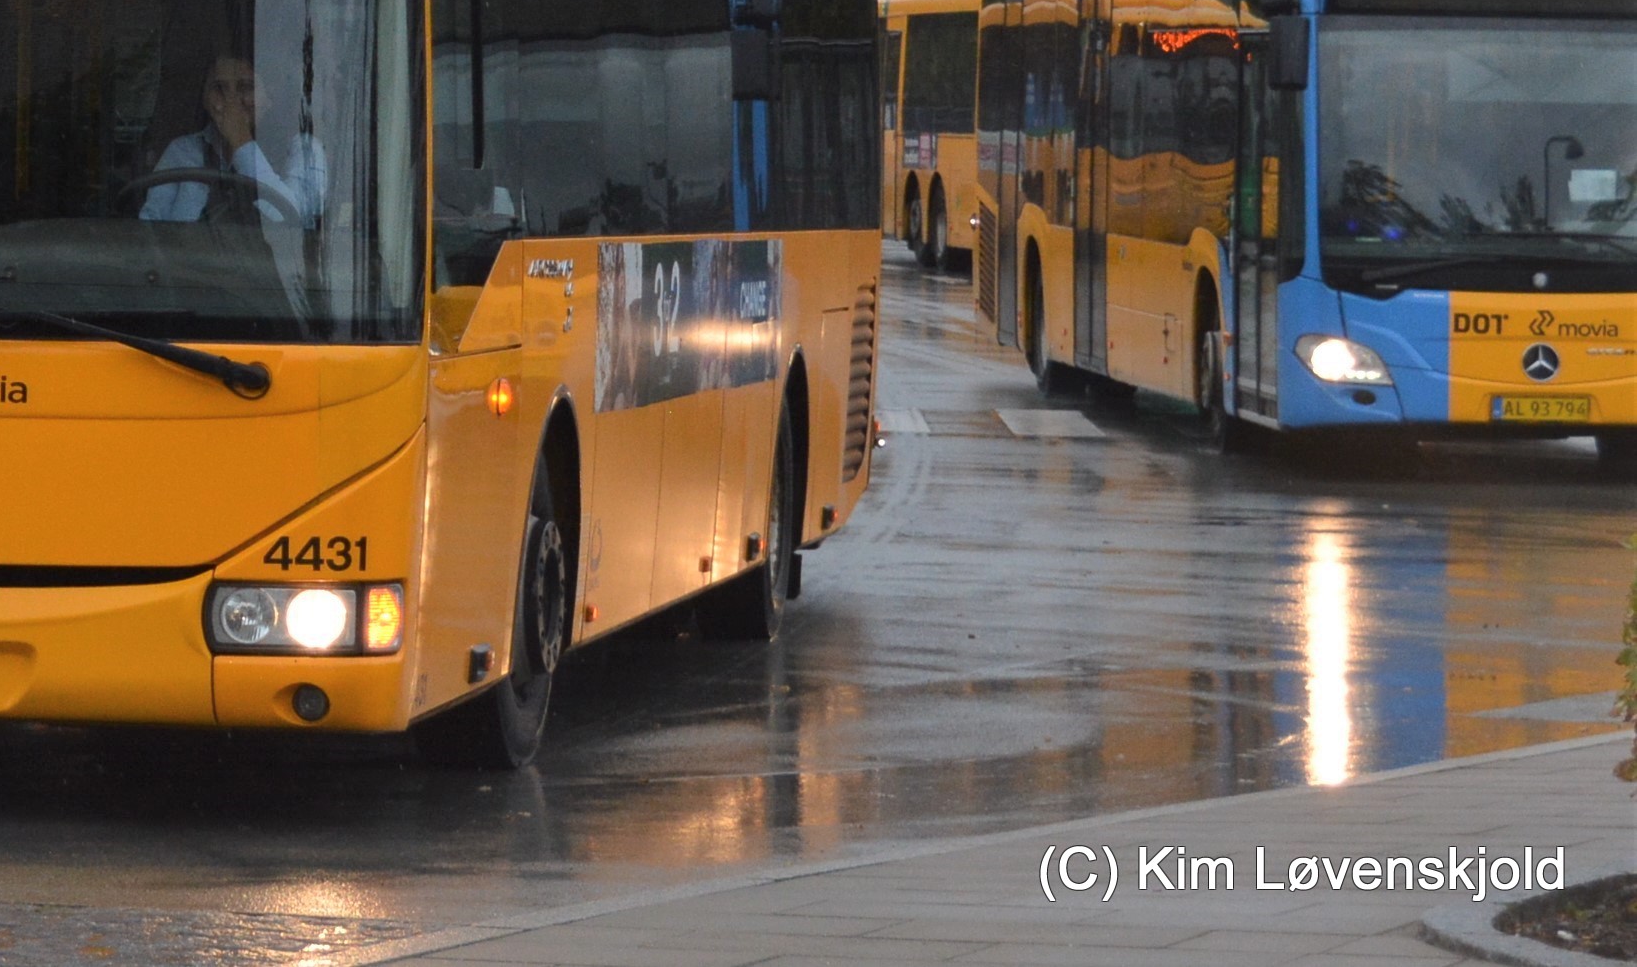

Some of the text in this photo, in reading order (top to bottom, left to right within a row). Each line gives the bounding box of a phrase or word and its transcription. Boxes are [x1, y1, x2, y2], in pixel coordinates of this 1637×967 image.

[1454, 313, 1618, 337] DOT movia
[1504, 401, 1524, 416] AL
[1531, 401, 1550, 416] 93
[264, 536, 367, 571] 4431
